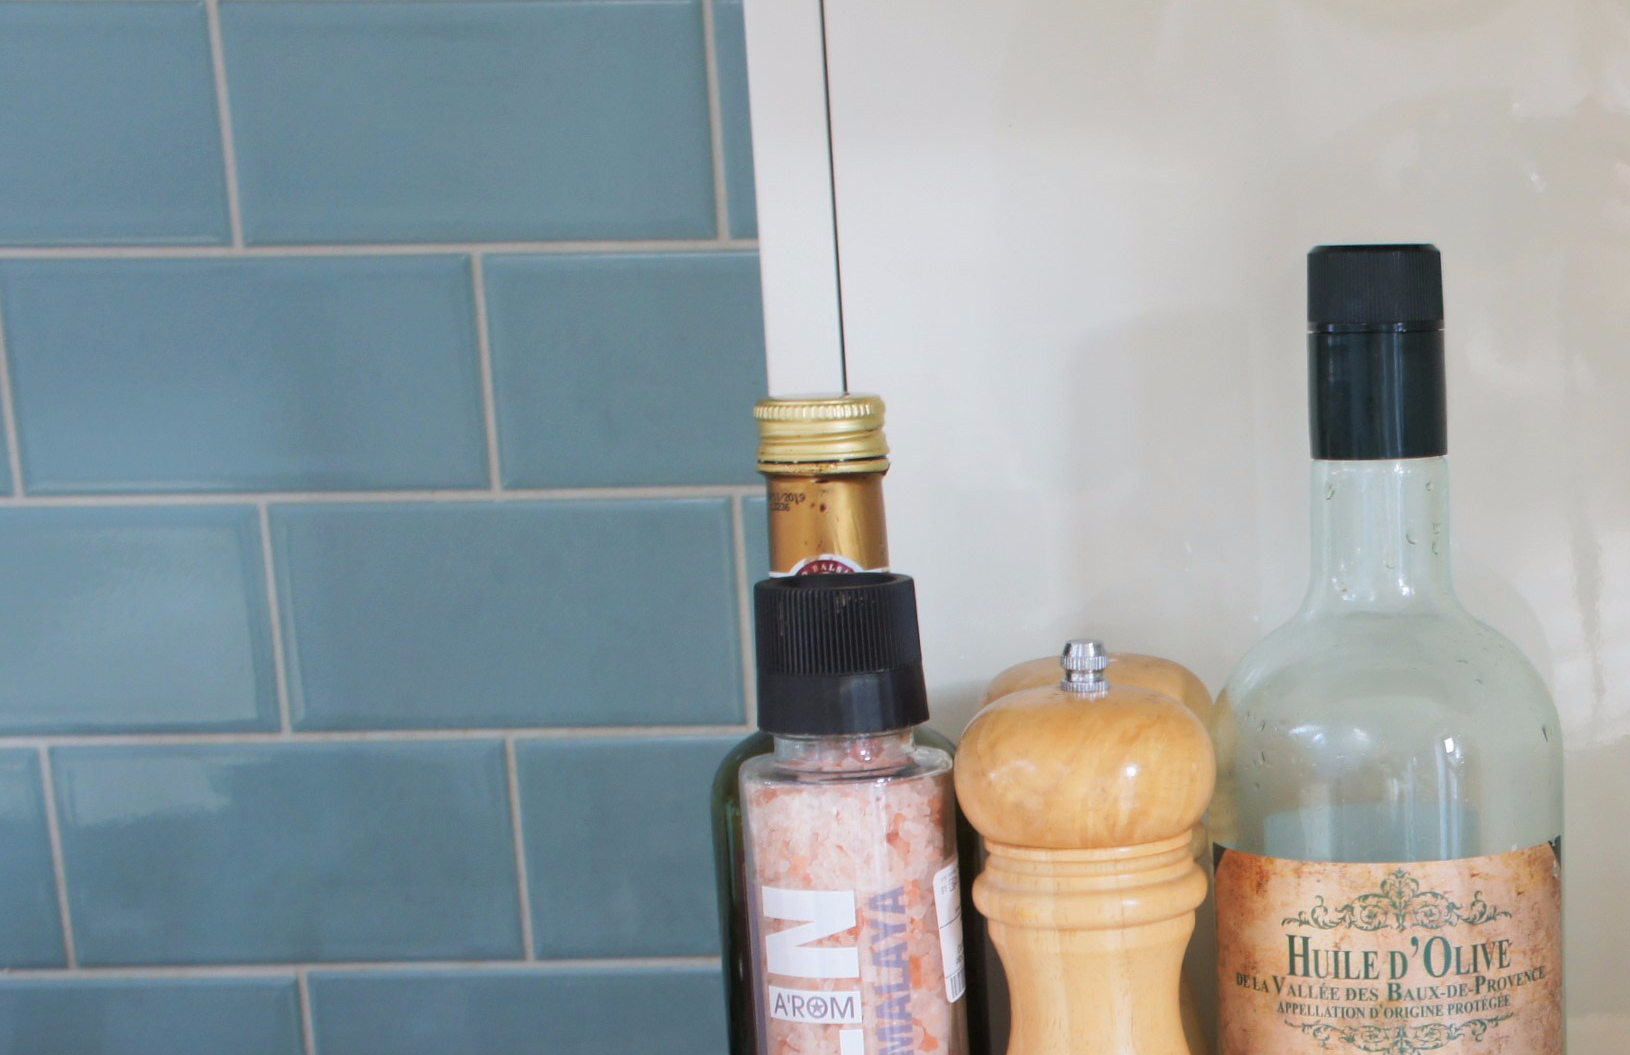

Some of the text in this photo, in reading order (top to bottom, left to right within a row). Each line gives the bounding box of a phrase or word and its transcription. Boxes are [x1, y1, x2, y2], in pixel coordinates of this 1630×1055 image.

[1285, 933, 1513, 981] HUILE D'OLIVE
[1236, 971, 1251, 987] DE
[1252, 974, 1270, 994] LA
[1271, 975, 1340, 1001] VALLÉE
[1345, 986, 1380, 1002] DES
[1276, 1002, 1365, 1019] APPELLATION
[1369, 1003, 1444, 1020] D'ORIGINE
